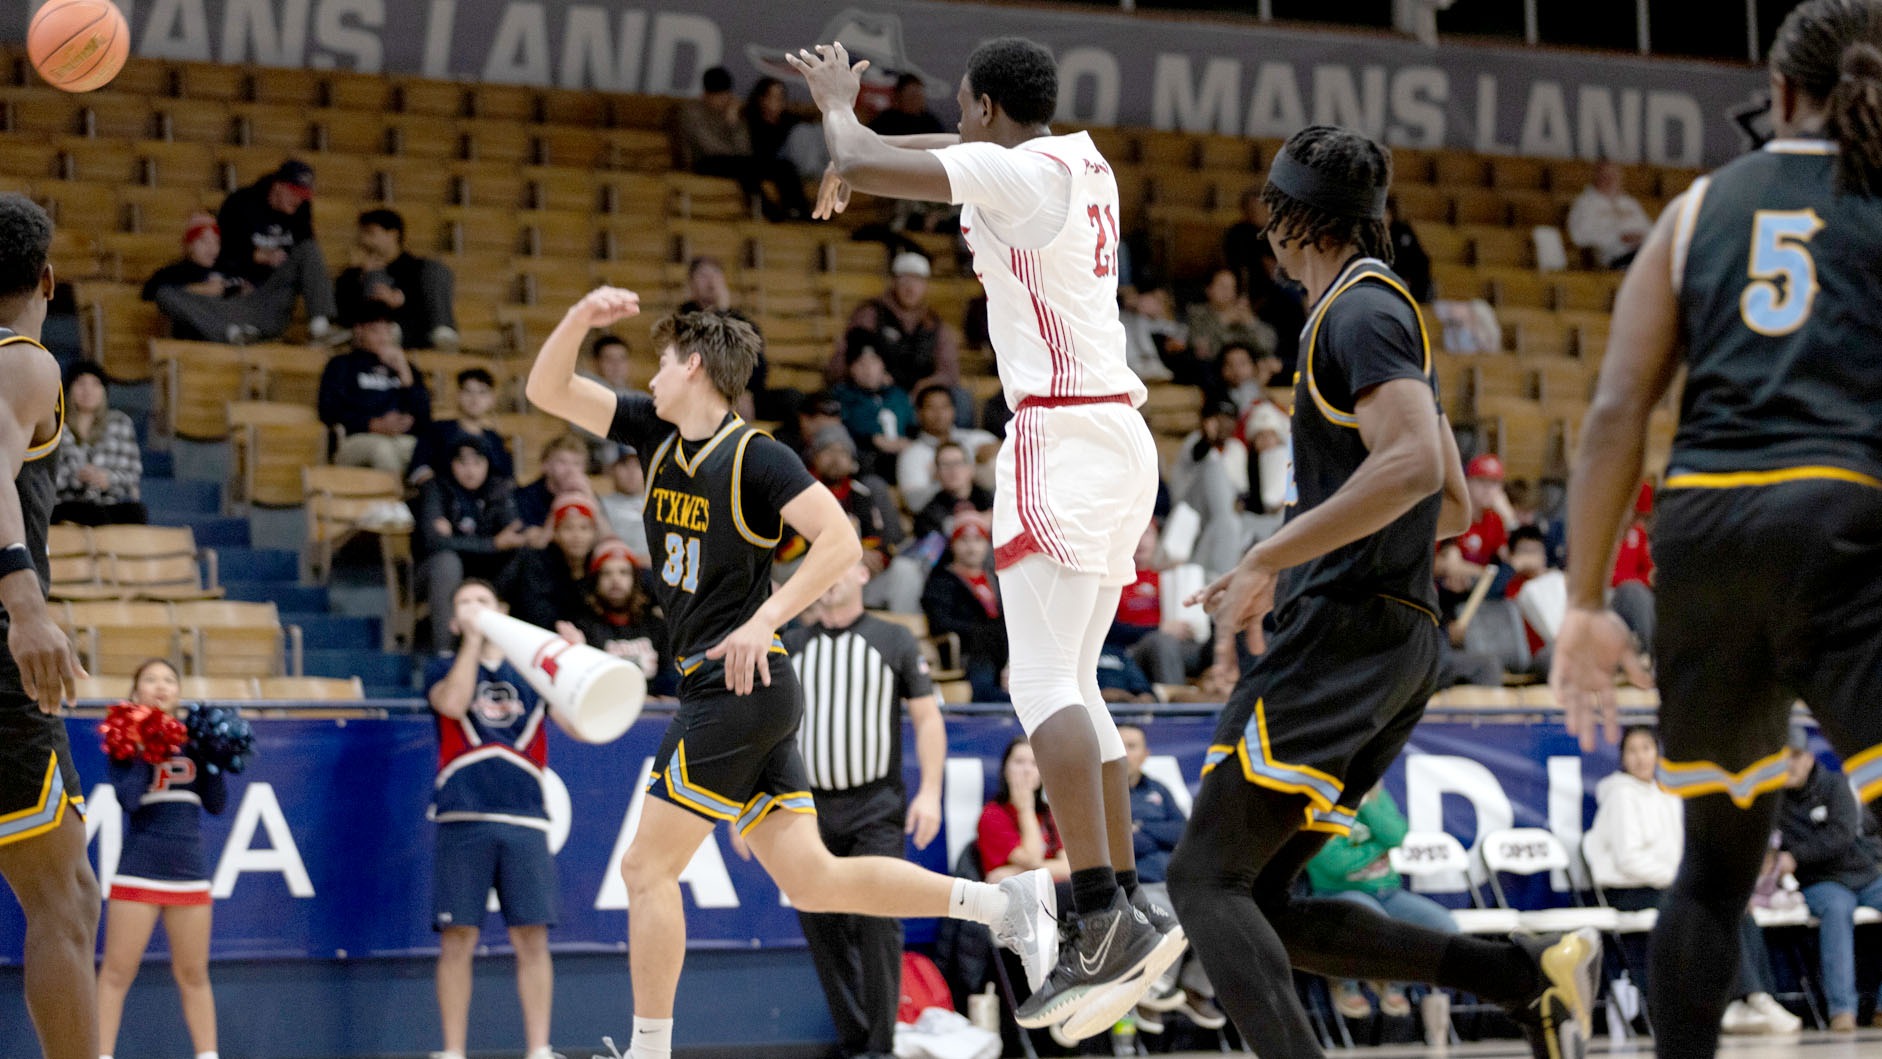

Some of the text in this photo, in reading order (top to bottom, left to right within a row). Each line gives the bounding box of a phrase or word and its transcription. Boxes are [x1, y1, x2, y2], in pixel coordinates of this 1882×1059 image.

[422, 0, 723, 98] LAND
[1152, 52, 1450, 150] MANS
[1475, 73, 1704, 169] LAND
[1087, 204, 1118, 278] 21
[1740, 207, 1825, 336] 5
[661, 532, 701, 594] 31
[150, 756, 197, 792] P
